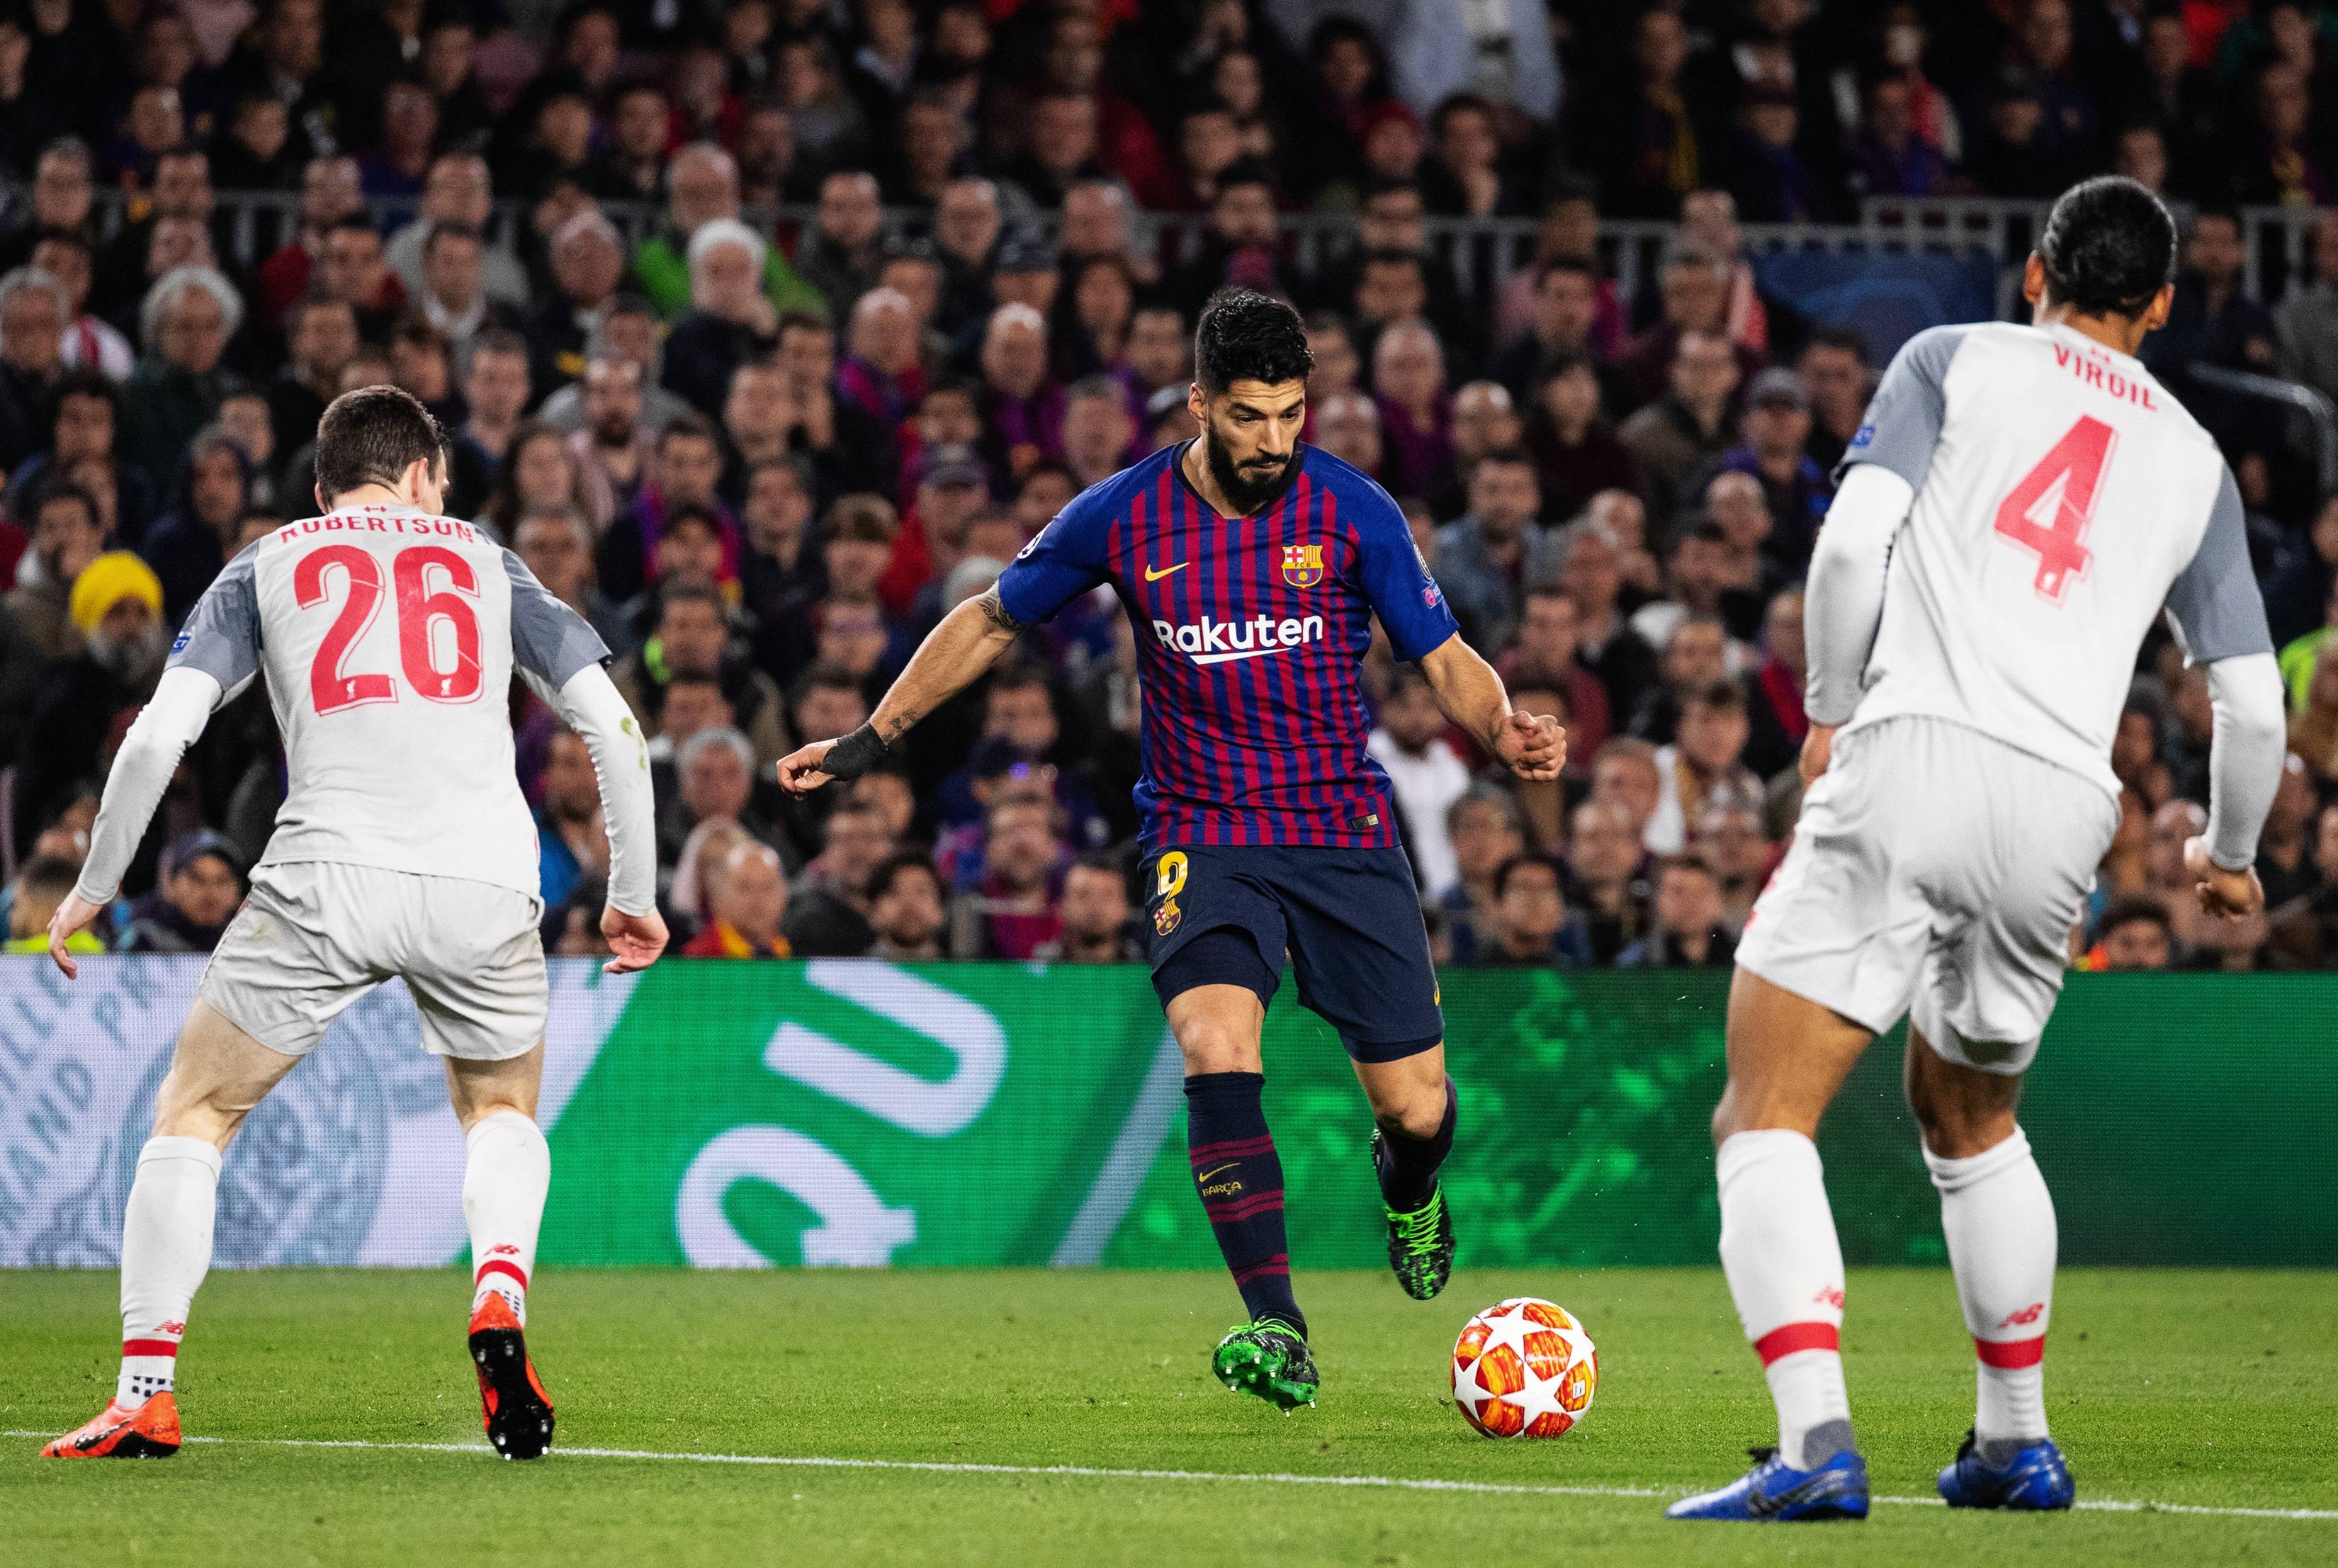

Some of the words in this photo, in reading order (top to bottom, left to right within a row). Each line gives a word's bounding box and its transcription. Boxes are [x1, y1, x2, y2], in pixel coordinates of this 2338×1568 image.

[1994, 414, 2118, 609] 4
[294, 544, 485, 716] 26
[1153, 614, 1323, 653] Rakuten
[1156, 851, 1188, 905] 9
[678, 959, 1046, 1268] QU
